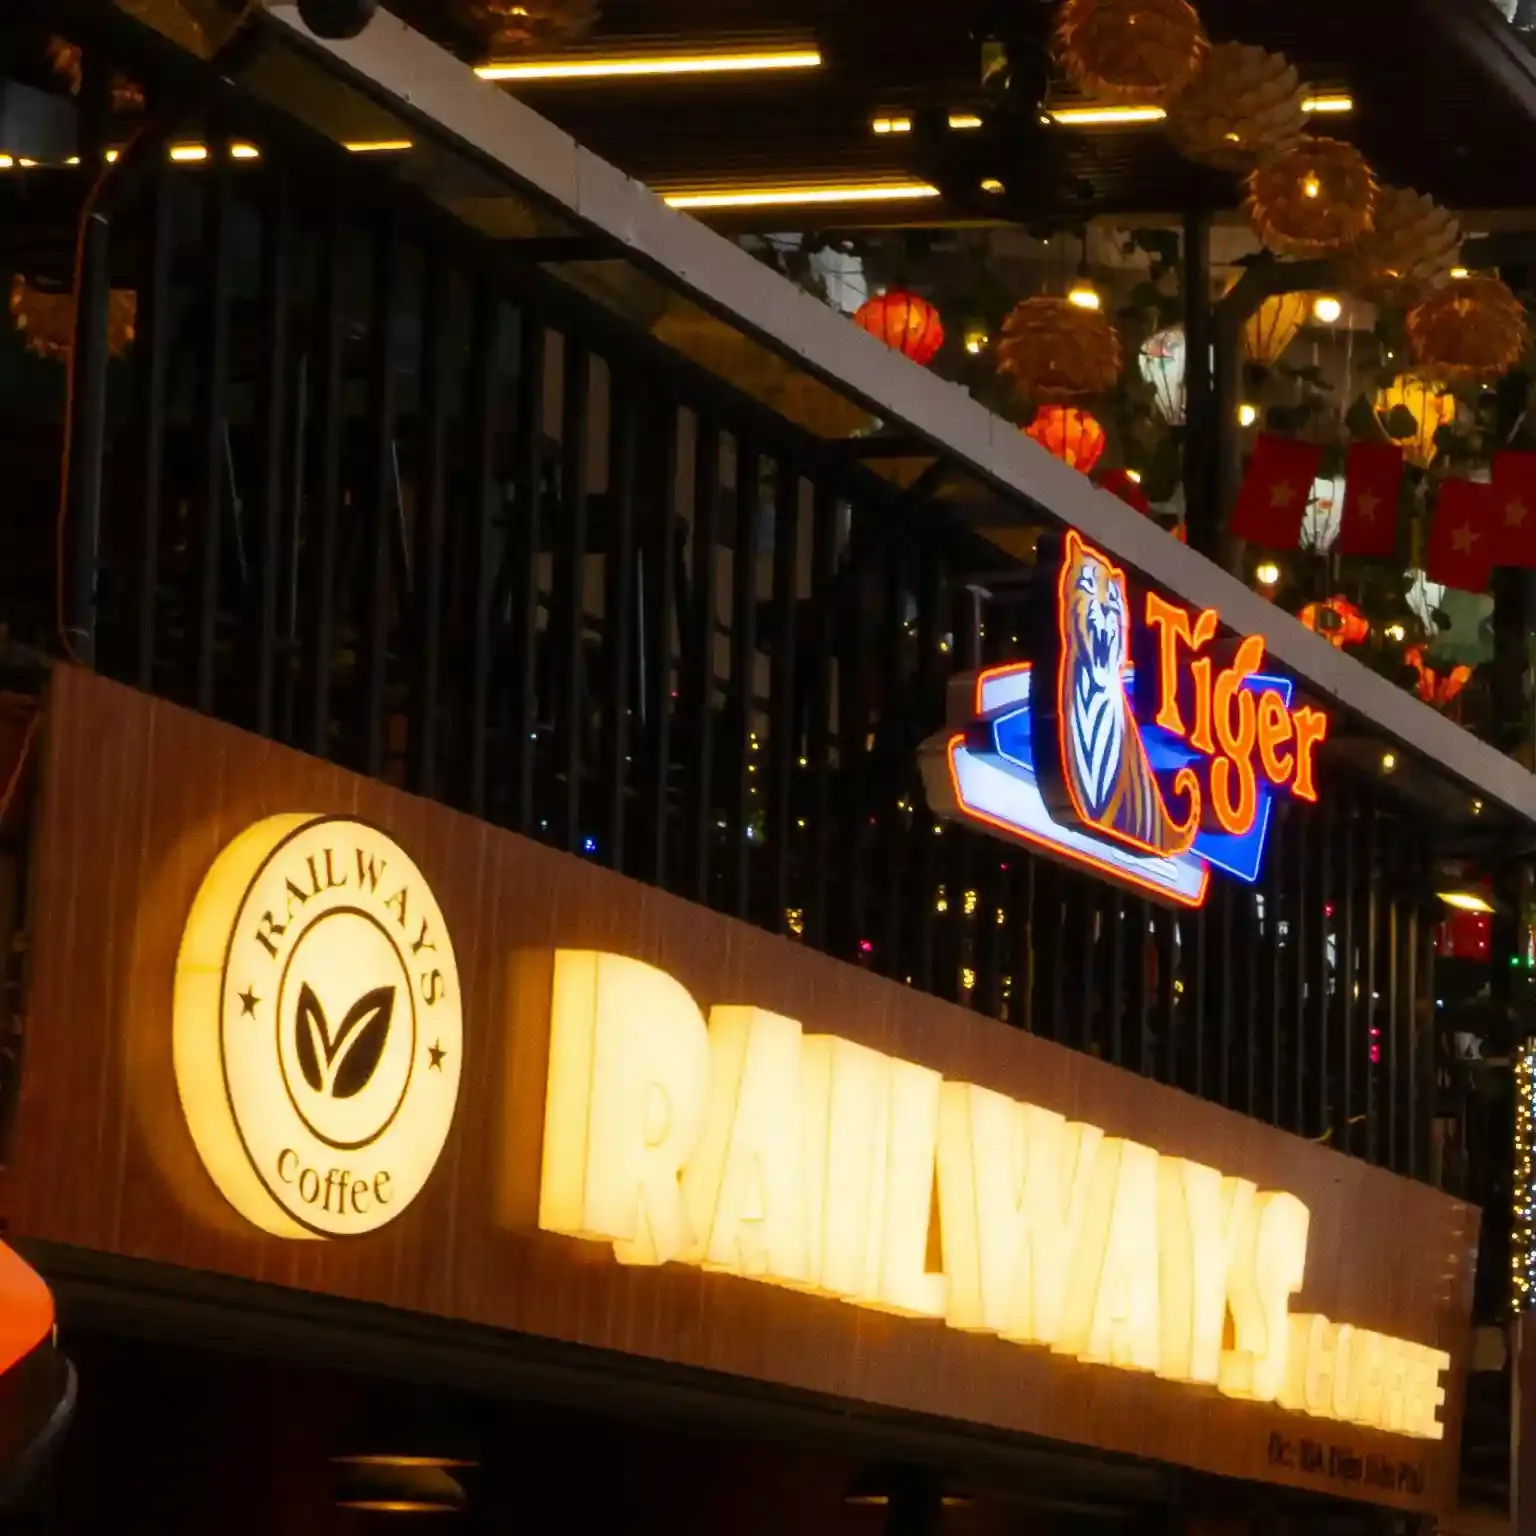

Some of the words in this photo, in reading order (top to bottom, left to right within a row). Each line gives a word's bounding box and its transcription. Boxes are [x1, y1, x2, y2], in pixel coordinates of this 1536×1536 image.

[1145, 590, 1328, 836] Tiger
[254, 846, 446, 1008] RAILWAYS
[540, 948, 1310, 1402] RAILWAYS
